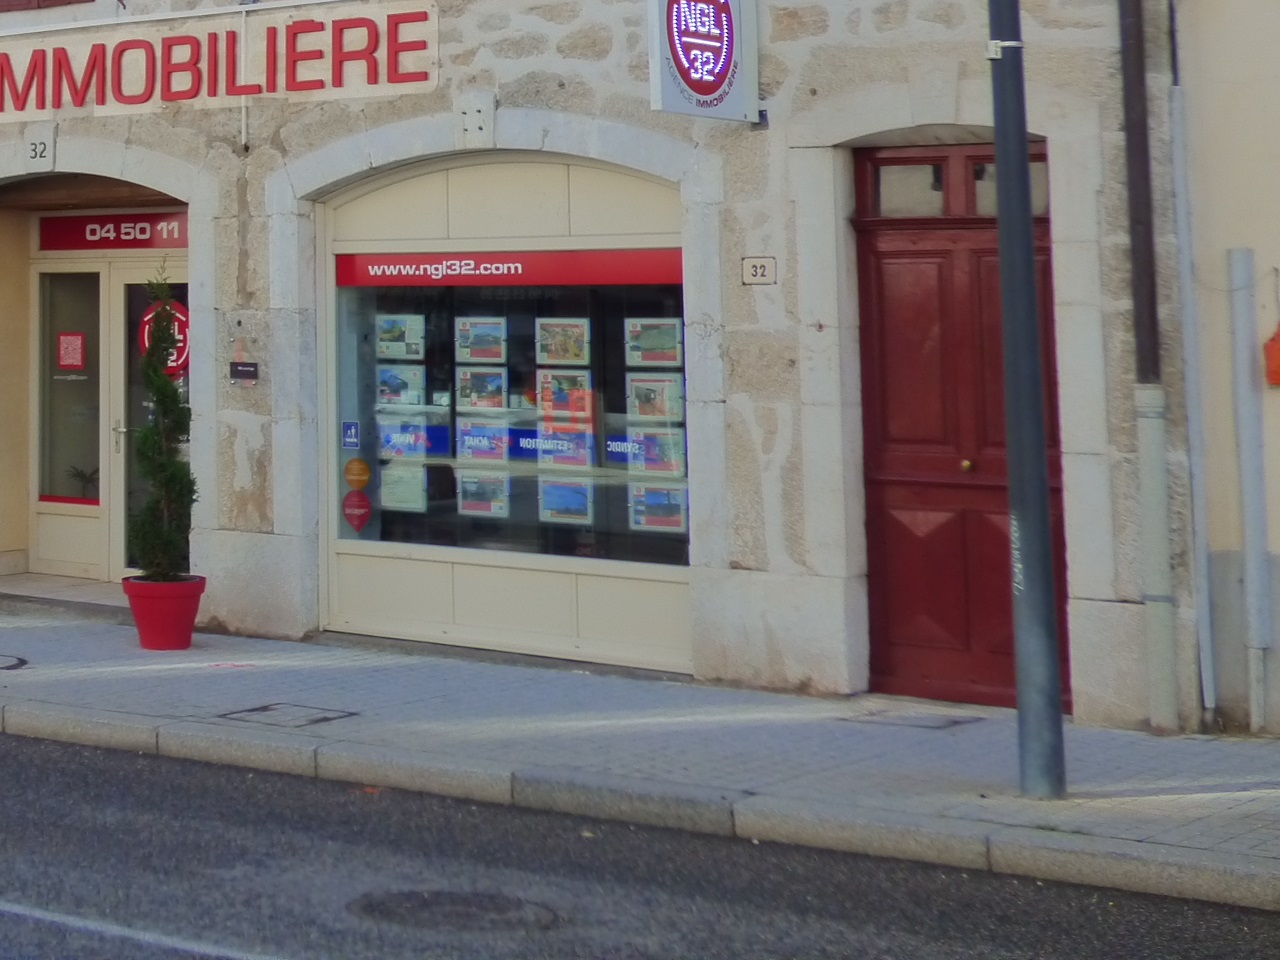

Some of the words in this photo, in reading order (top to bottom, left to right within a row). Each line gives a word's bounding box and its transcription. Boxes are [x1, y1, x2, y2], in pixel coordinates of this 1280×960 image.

[680, 0, 721, 36] NGL
[690, 49, 715, 82] 32
[29, 142, 47, 159] 32
[86, 223, 116, 240] 04
[120, 222, 151, 240] 50
[156, 221, 179, 239] 11
[368, 260, 522, 279] www.ngl32.com
[751, 264, 766, 277] 32
